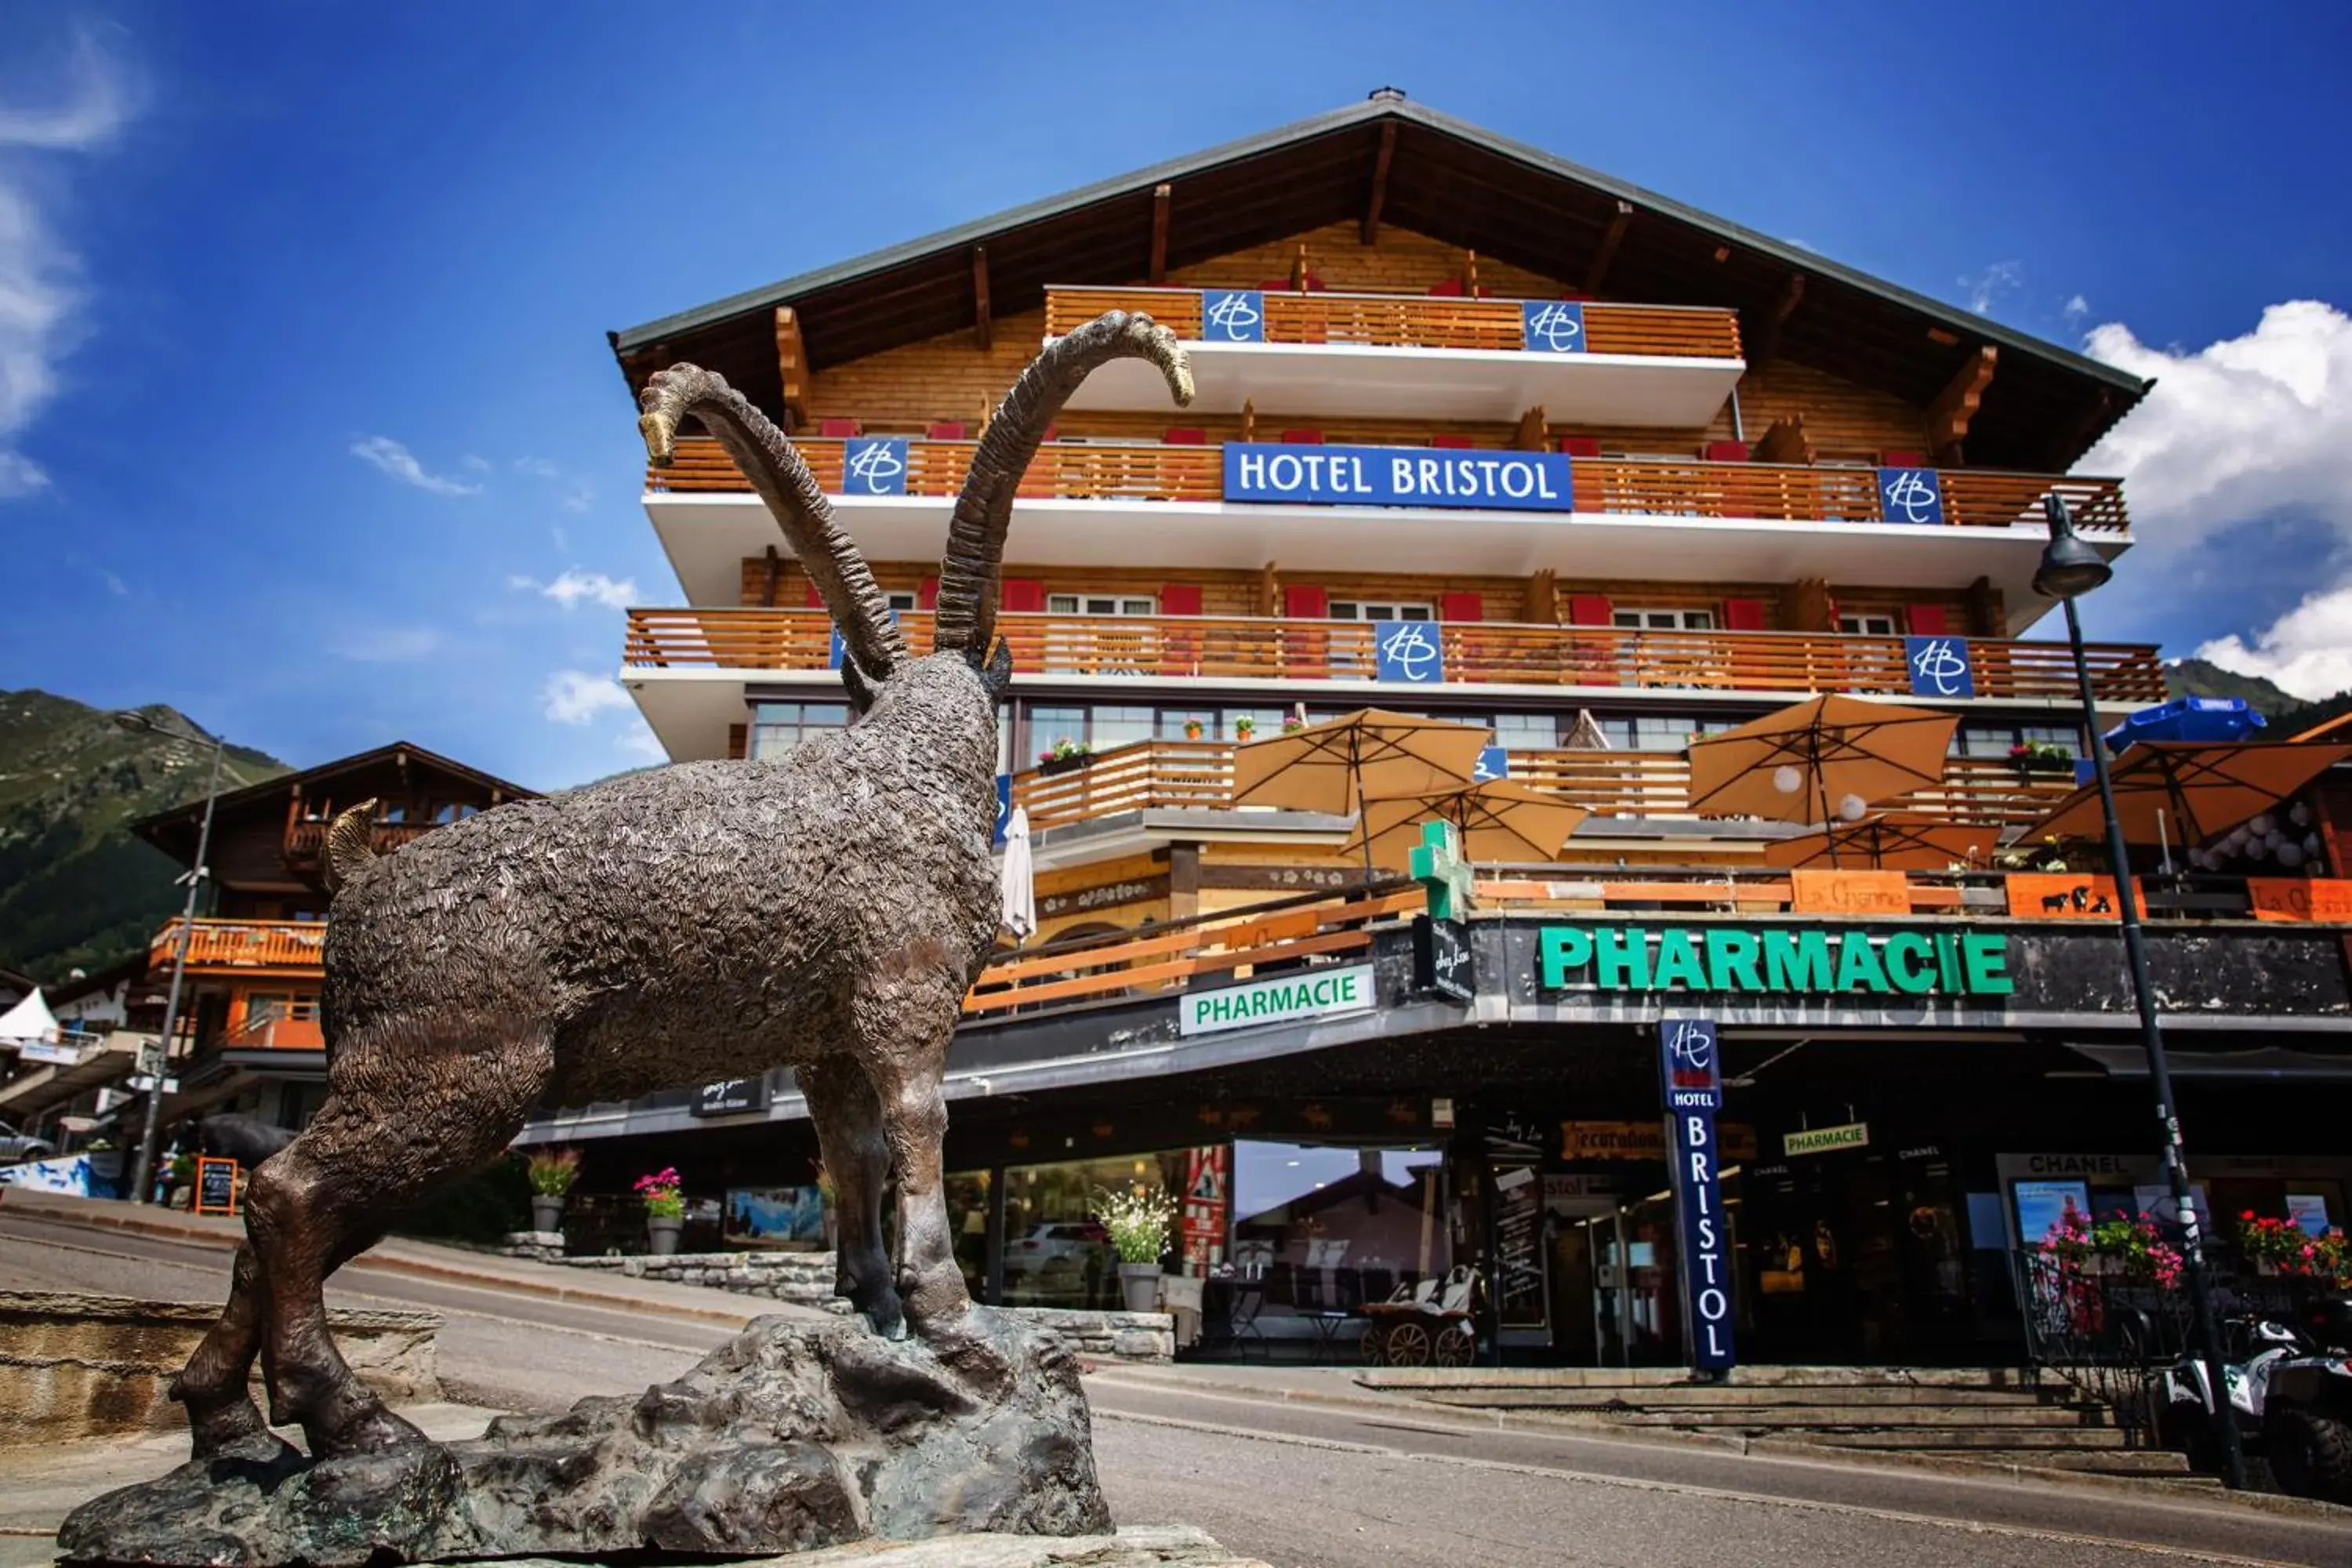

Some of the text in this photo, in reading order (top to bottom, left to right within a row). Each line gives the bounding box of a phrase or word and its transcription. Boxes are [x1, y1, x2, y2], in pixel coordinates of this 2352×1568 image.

[1240, 453, 1557, 499] HOTEL BRISTOL
[1539, 926, 2014, 995] PHARMACIE
[1196, 975, 1356, 1025] PHARMACIE
[1675, 1093, 1714, 1106] HOTEL
[1788, 1127, 1864, 1152] PHARMACIE
[2030, 1156, 2129, 1174] CHANEL
[1687, 1116, 1726, 1356] BRISTOL
